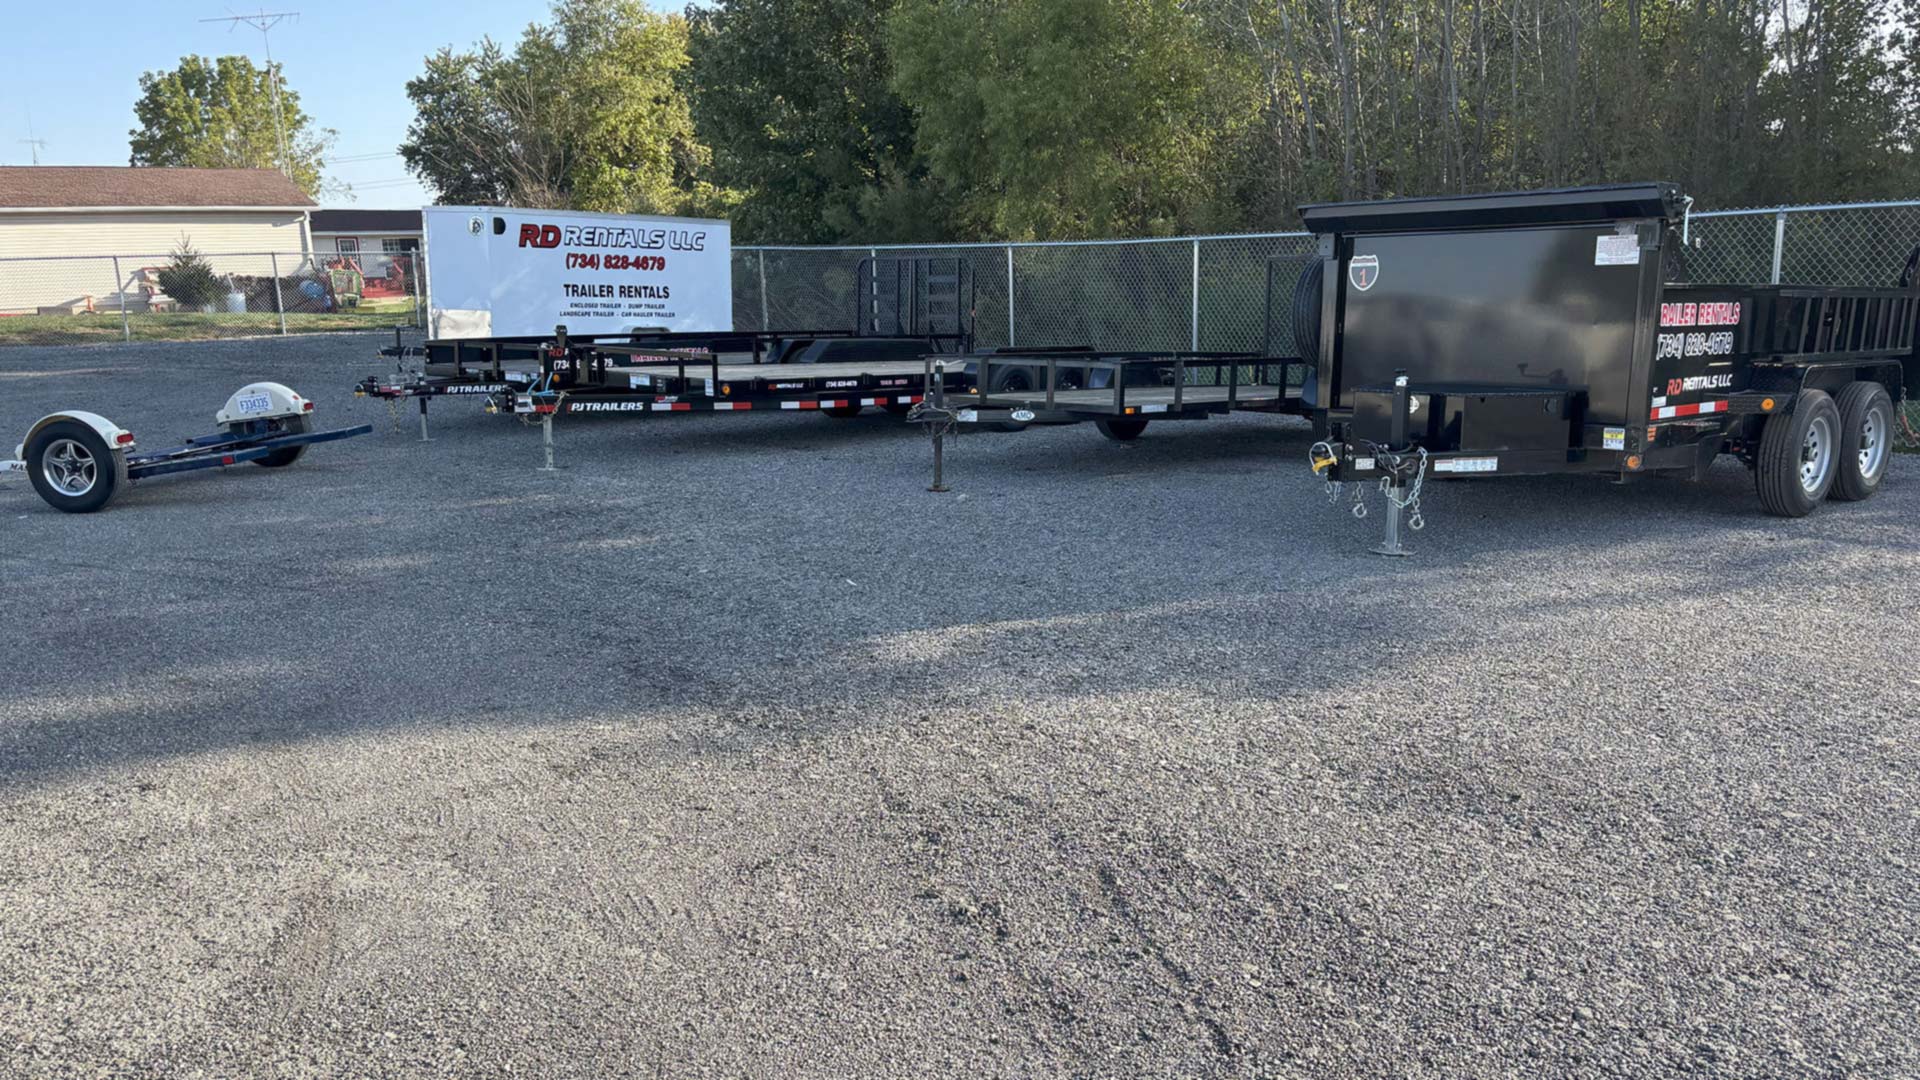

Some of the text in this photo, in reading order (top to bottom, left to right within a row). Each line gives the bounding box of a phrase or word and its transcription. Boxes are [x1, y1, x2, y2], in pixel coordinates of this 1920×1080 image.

[518, 223, 706, 251] RD RENTALS LLC
[565, 253, 666, 271] (734) 828-4679
[1359, 268, 1368, 286] 1
[563, 284, 670, 299] TRAILER RENTALS
[1660, 302, 1741, 327] RAILER RENTALS
[1656, 331, 1734, 360] (734) 828-4679
[1666, 373, 1733, 396] RD RENTALS LLC
